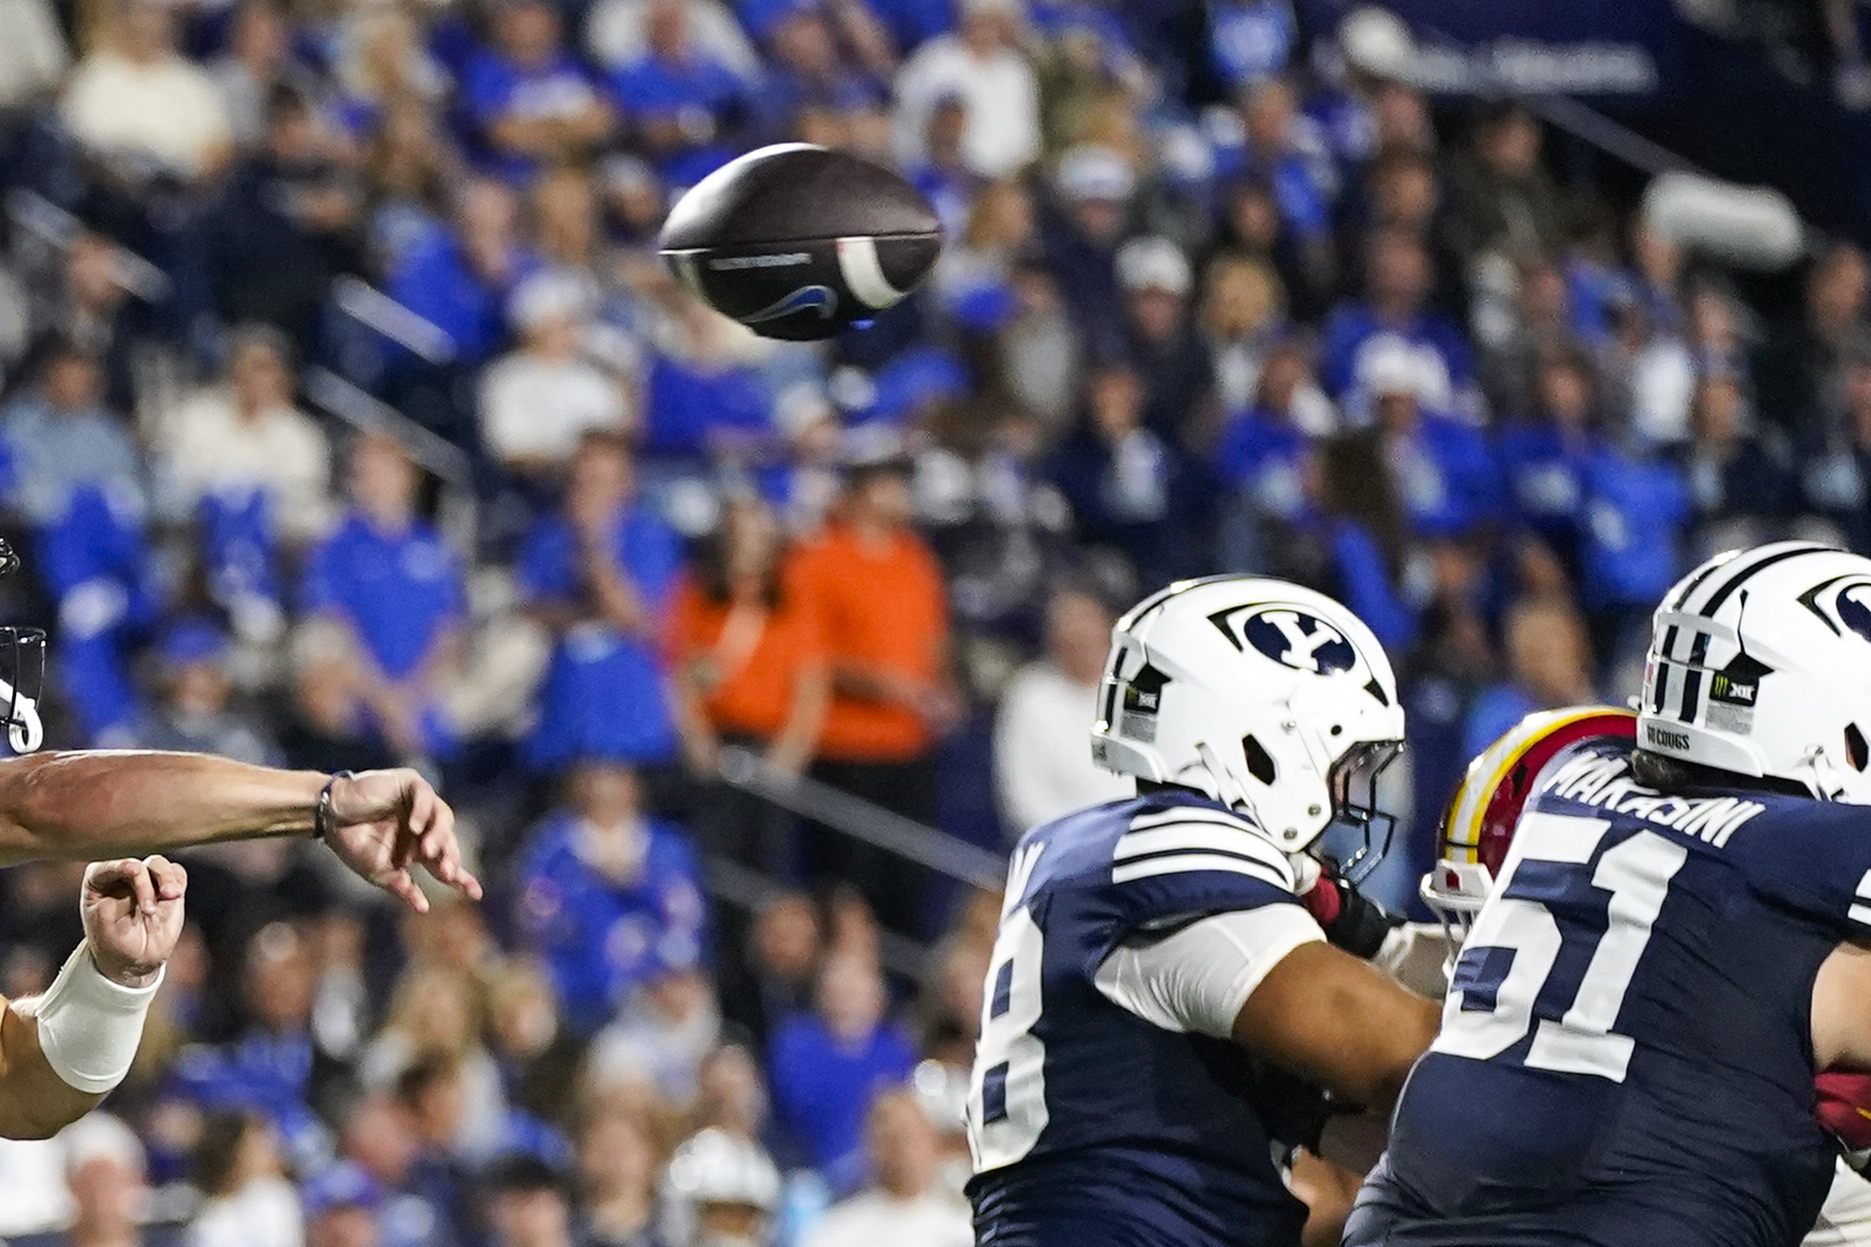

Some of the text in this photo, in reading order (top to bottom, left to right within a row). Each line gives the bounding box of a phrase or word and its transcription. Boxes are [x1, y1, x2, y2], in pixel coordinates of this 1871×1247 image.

[1259, 610, 1344, 673] Y
[1657, 729, 1690, 750] COUGS
[1430, 812, 1689, 1084] 51
